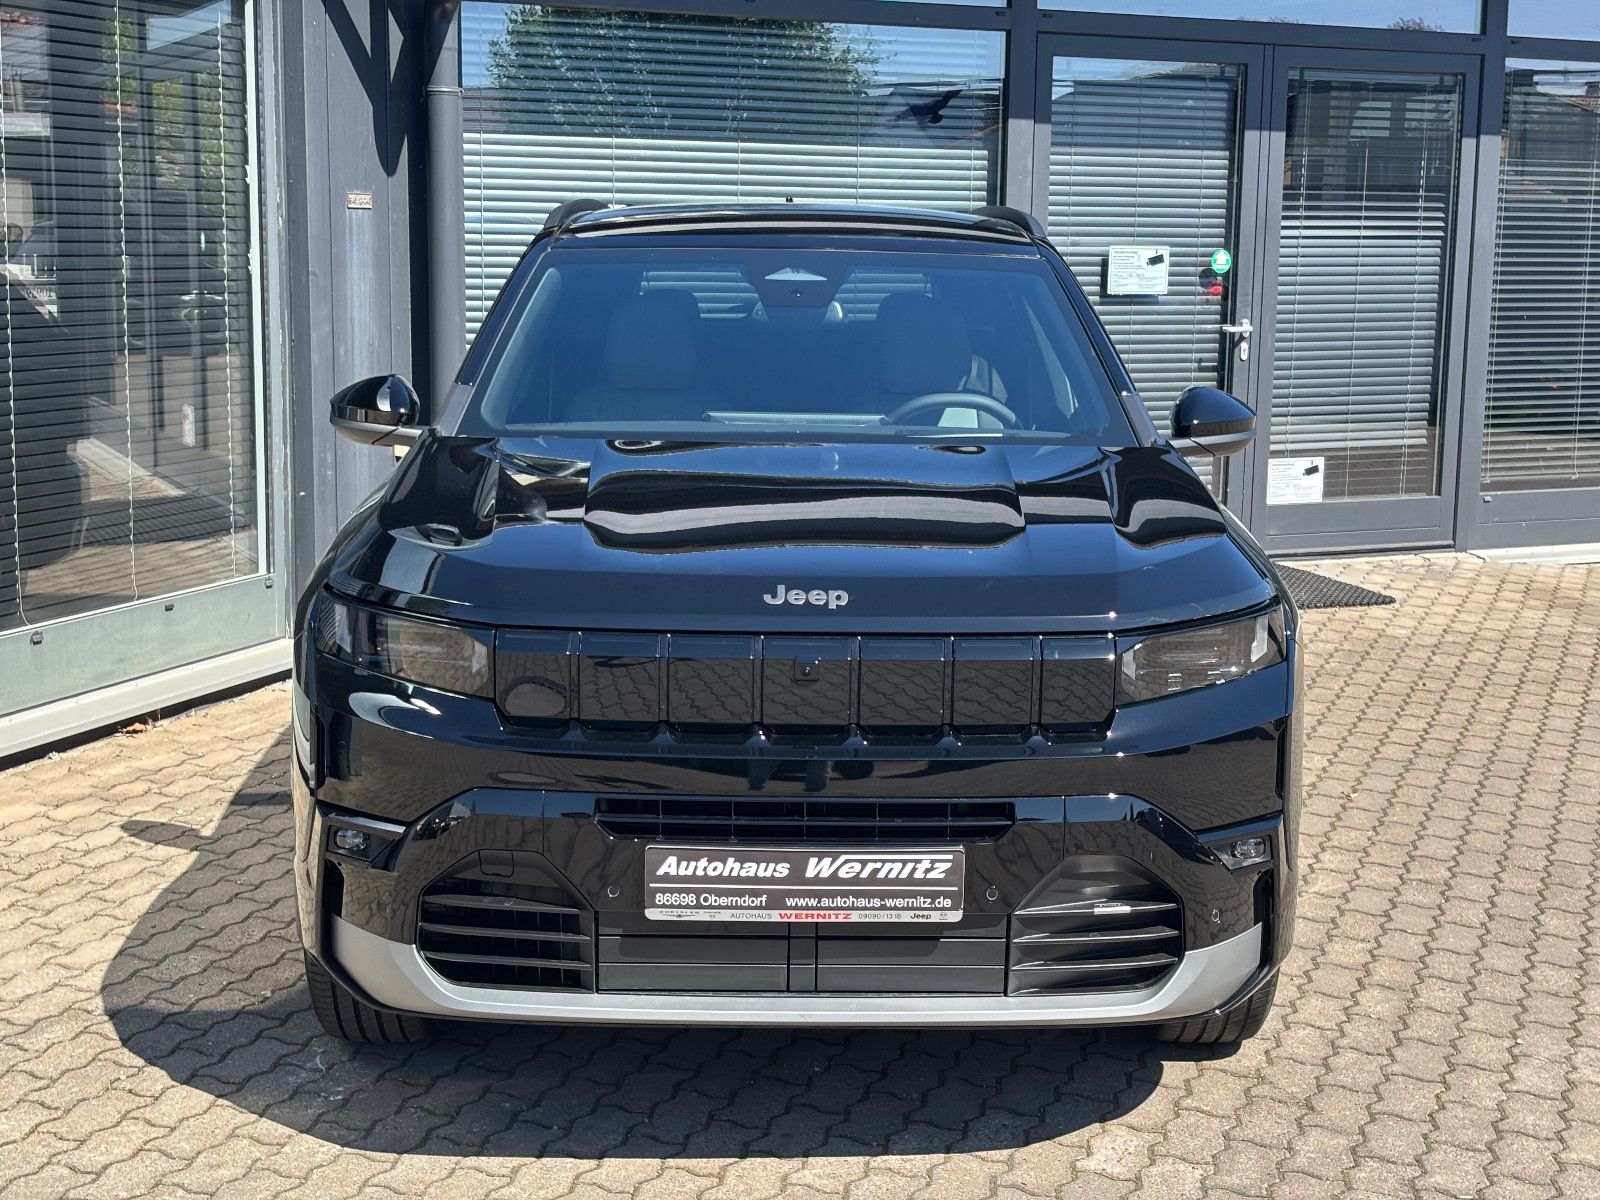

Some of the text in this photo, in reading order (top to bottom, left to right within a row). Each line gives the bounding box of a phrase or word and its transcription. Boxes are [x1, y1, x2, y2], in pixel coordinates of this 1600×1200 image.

[763, 584, 849, 609] Jeep
[655, 854, 954, 879] Autohaus Wernitz
[655, 893, 952, 908] 86698 Oberndorf www.autohaus-wernitz.de
[730, 912, 773, 920] AUTOHAUS
[778, 912, 853, 920] WERNITZ
[910, 912, 932, 920] Jeep
